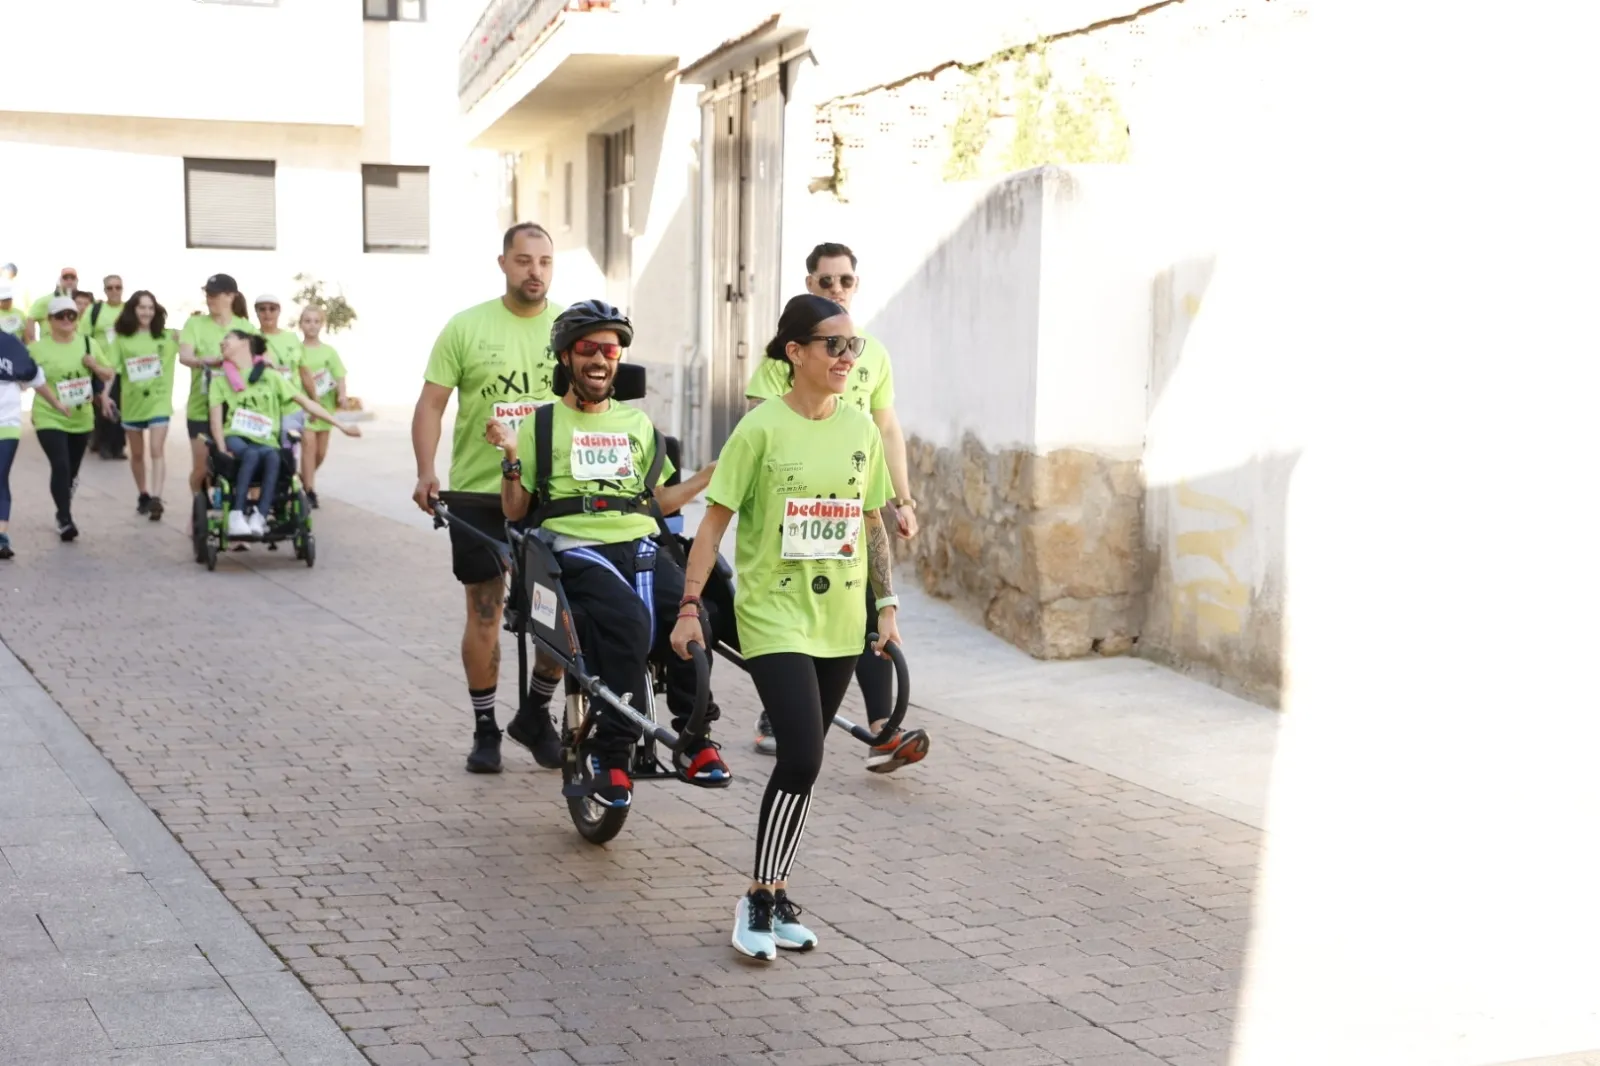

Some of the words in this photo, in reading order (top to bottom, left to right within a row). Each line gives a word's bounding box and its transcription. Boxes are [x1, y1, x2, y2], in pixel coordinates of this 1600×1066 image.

[498, 370, 530, 395] XI
[577, 449, 618, 465] 1066
[786, 501, 861, 518] bedunia
[800, 519, 847, 541] 1068
